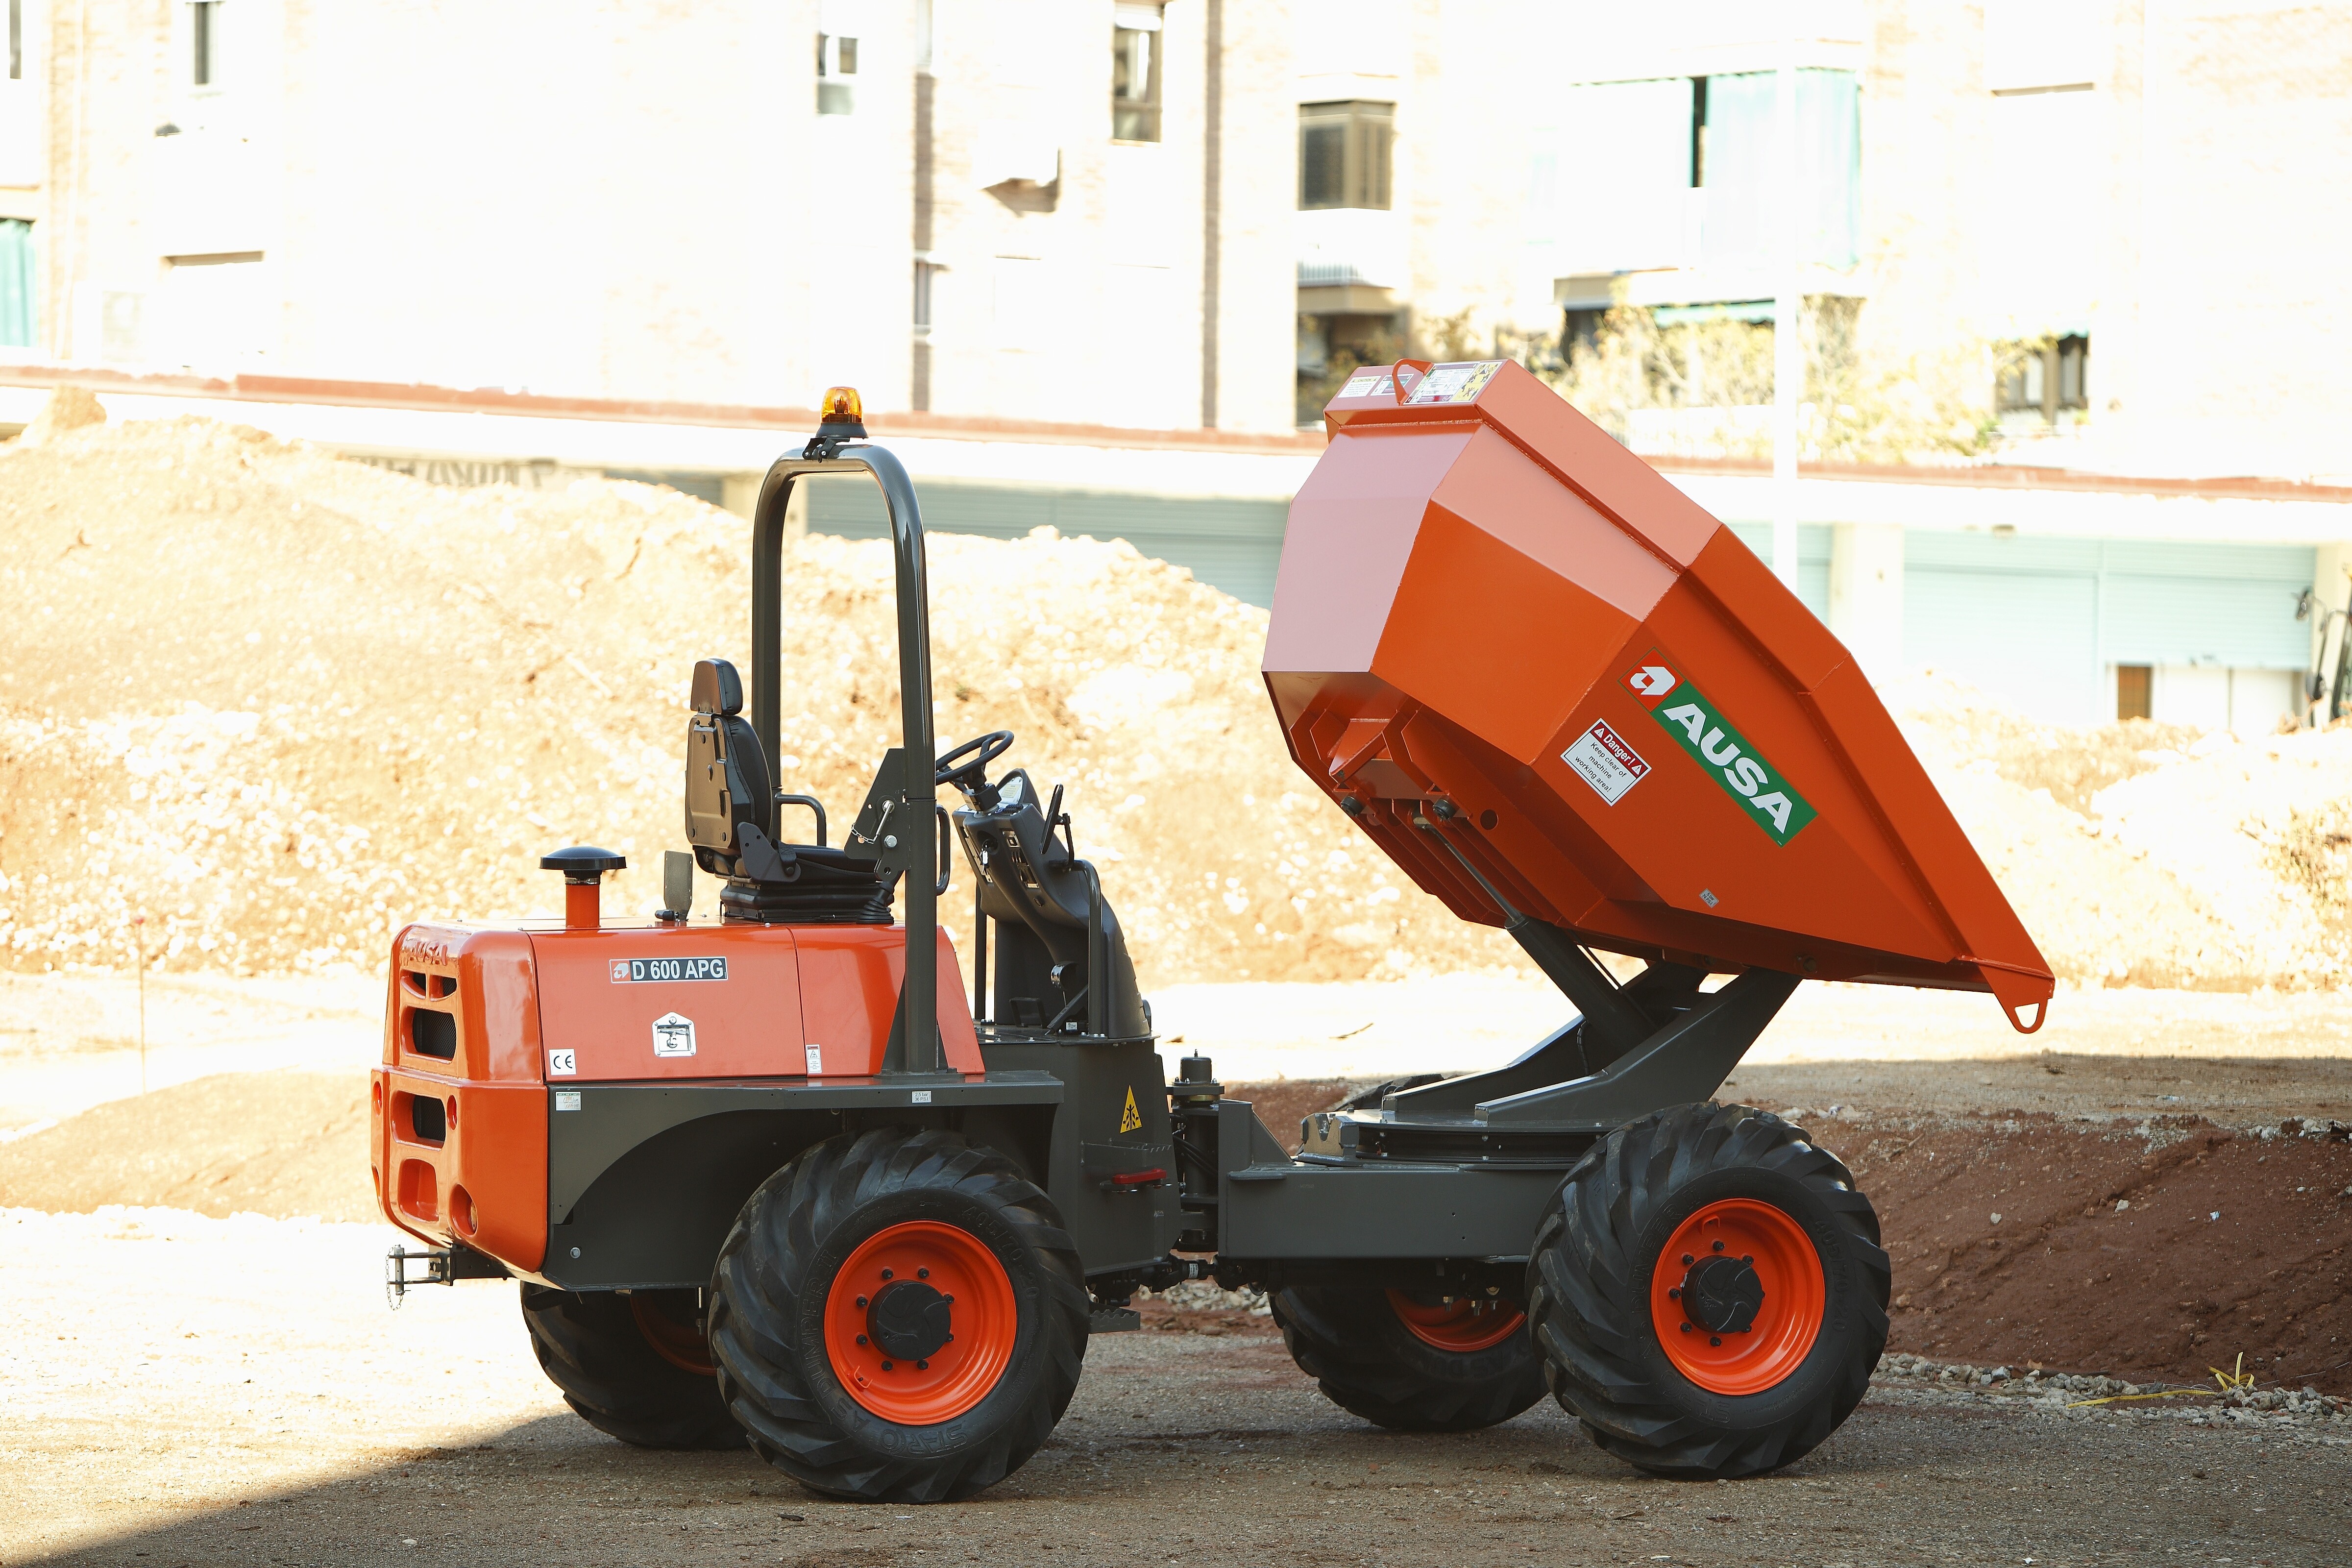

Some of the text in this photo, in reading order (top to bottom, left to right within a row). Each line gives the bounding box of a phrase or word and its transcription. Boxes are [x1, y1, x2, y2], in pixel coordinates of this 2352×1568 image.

[1588, 755, 1612, 779] machine
[1591, 742, 1627, 778] Keep clear of
[1603, 734, 1636, 766] Danger!
[1662, 702, 1793, 834] AUSA
[1575, 756, 1612, 792] working area!
[632, 959, 724, 980] D 600 APG
[1630, 1202, 1685, 1313] DUMPER
[801, 1276, 836, 1399] DUMPER
